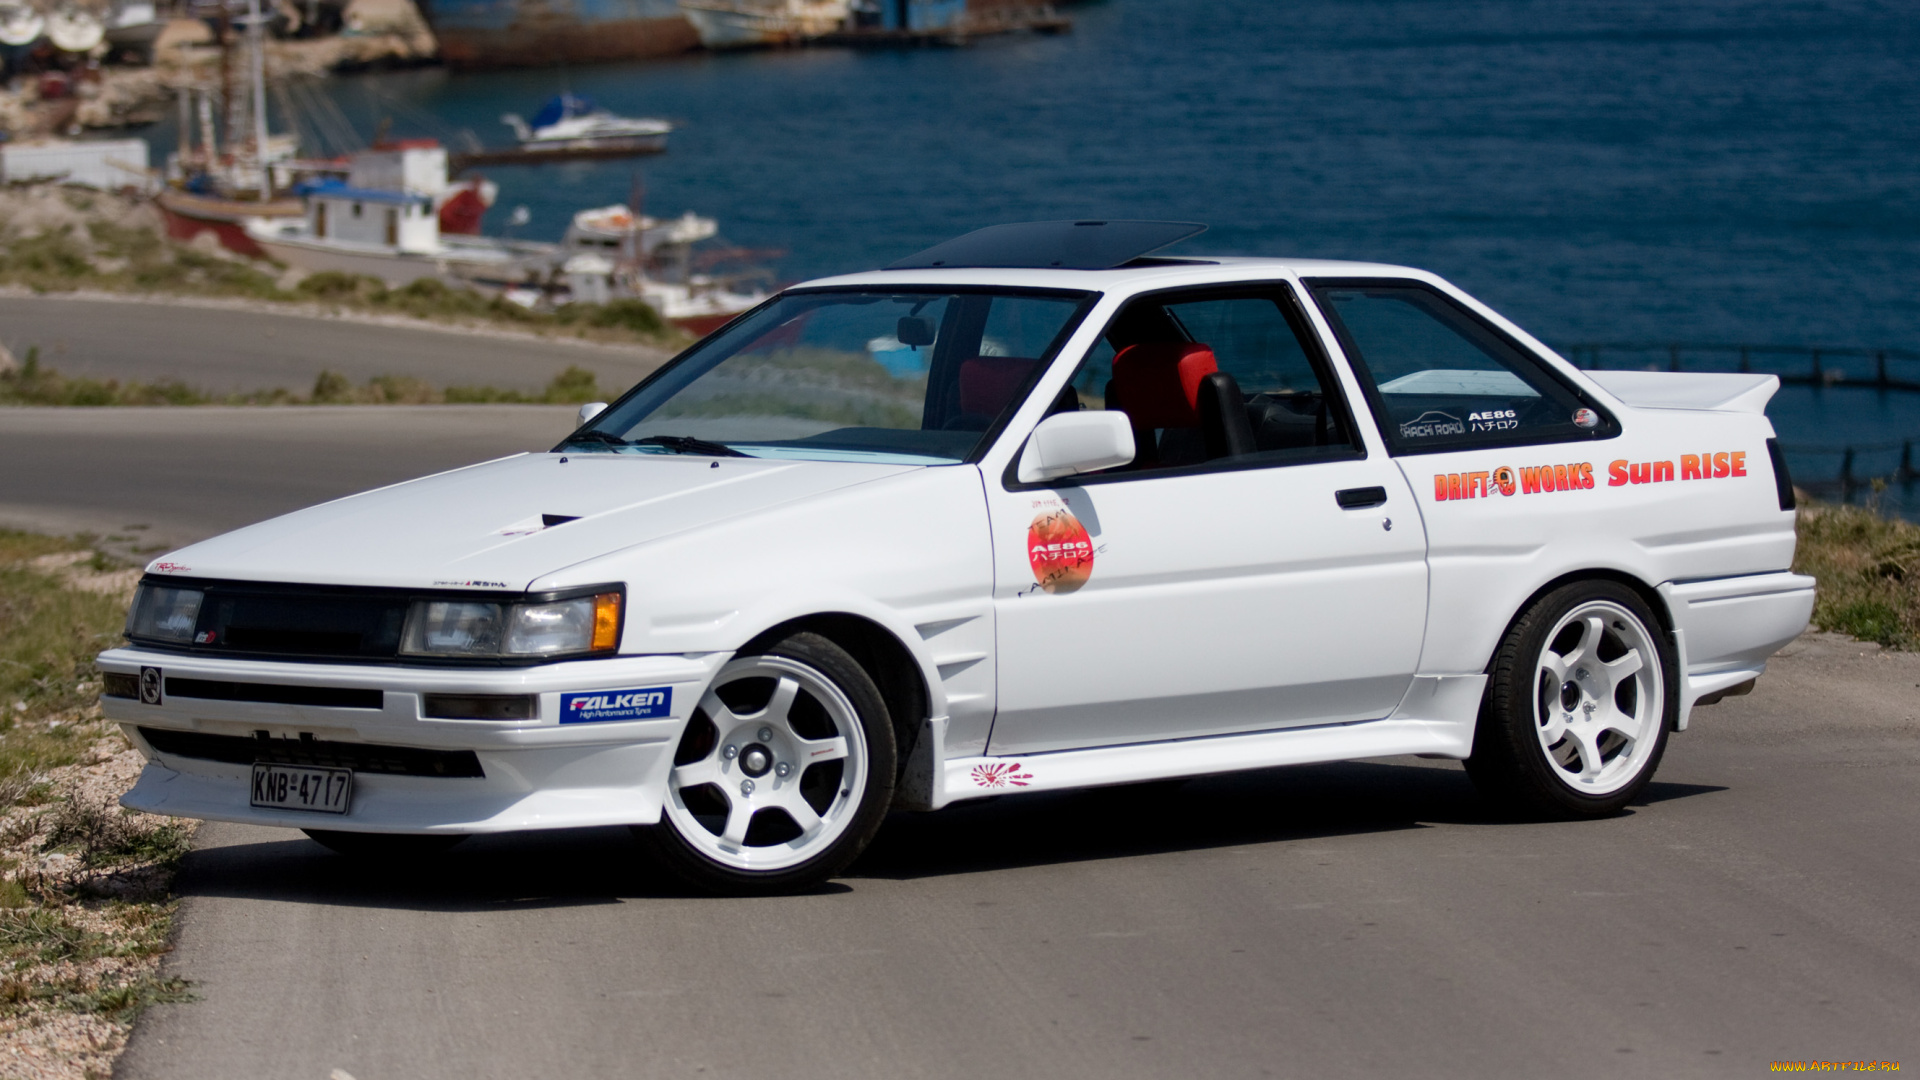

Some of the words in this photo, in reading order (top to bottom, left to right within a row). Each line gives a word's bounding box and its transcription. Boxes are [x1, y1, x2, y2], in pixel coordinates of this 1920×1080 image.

[1468, 409, 1516, 421] AE86
[1471, 419, 1518, 432] ハチロク
[1680, 451, 1747, 481] RISE
[1434, 471, 1490, 502] DRIFT
[1519, 462, 1595, 495] WORKS
[1031, 542, 1088, 553] AE86
[1032, 550, 1090, 562] ハチロク
[570, 692, 664, 711] FALKEN
[580, 711, 595, 720] High
[595, 708, 634, 717] Performance
[635, 707, 652, 716] Tyres
